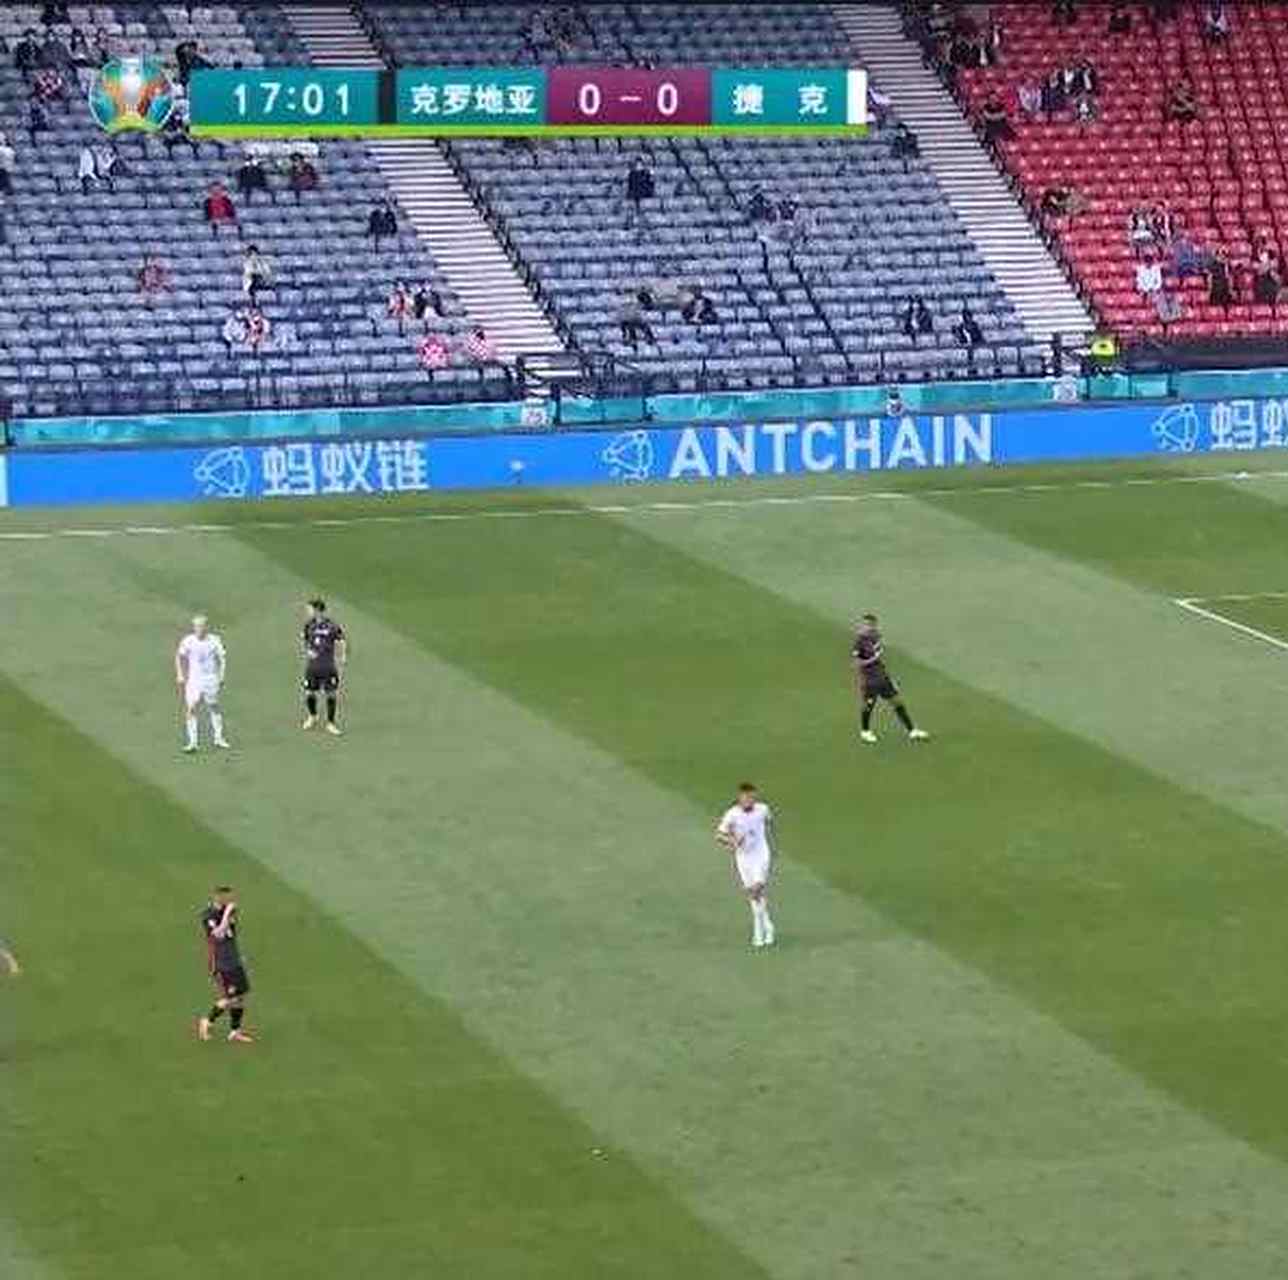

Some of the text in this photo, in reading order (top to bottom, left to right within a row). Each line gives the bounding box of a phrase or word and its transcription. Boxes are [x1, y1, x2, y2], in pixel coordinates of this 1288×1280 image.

[262, 440, 430, 495] 蚂蚁链
[669, 413, 993, 479] ANTCHAIN
